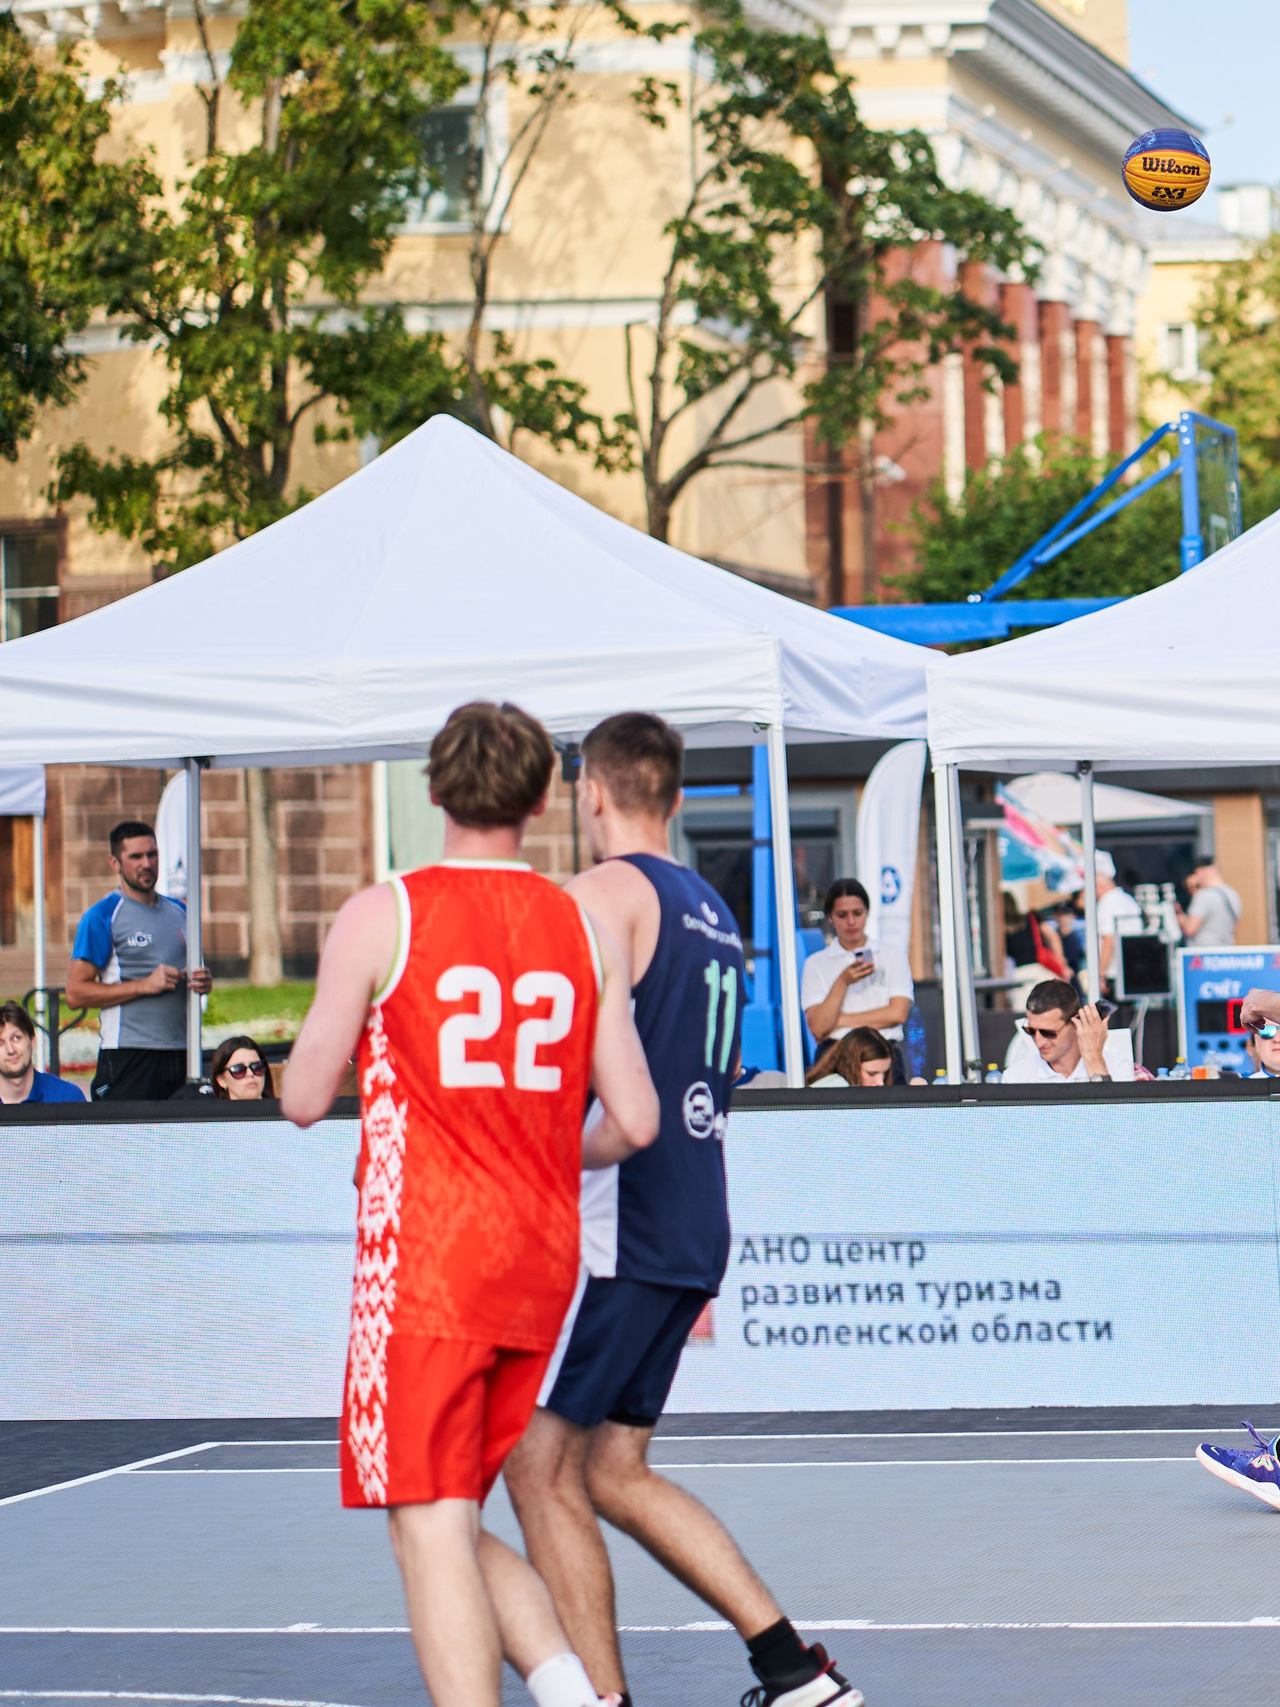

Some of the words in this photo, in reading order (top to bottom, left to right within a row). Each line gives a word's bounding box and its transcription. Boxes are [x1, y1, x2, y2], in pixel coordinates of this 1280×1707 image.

[1143, 156, 1200, 176] Wilson
[1200, 978, 1241, 998] СЧЁТ
[436, 965, 575, 1092] 22
[704, 958, 737, 1074] 11
[740, 1235, 810, 1264] АНО
[824, 1240, 926, 1268] центр
[741, 1282, 904, 1312] развития
[916, 1279, 1061, 1310] туризма
[743, 1314, 958, 1347] Смоленской
[971, 1312, 1112, 1343] области
